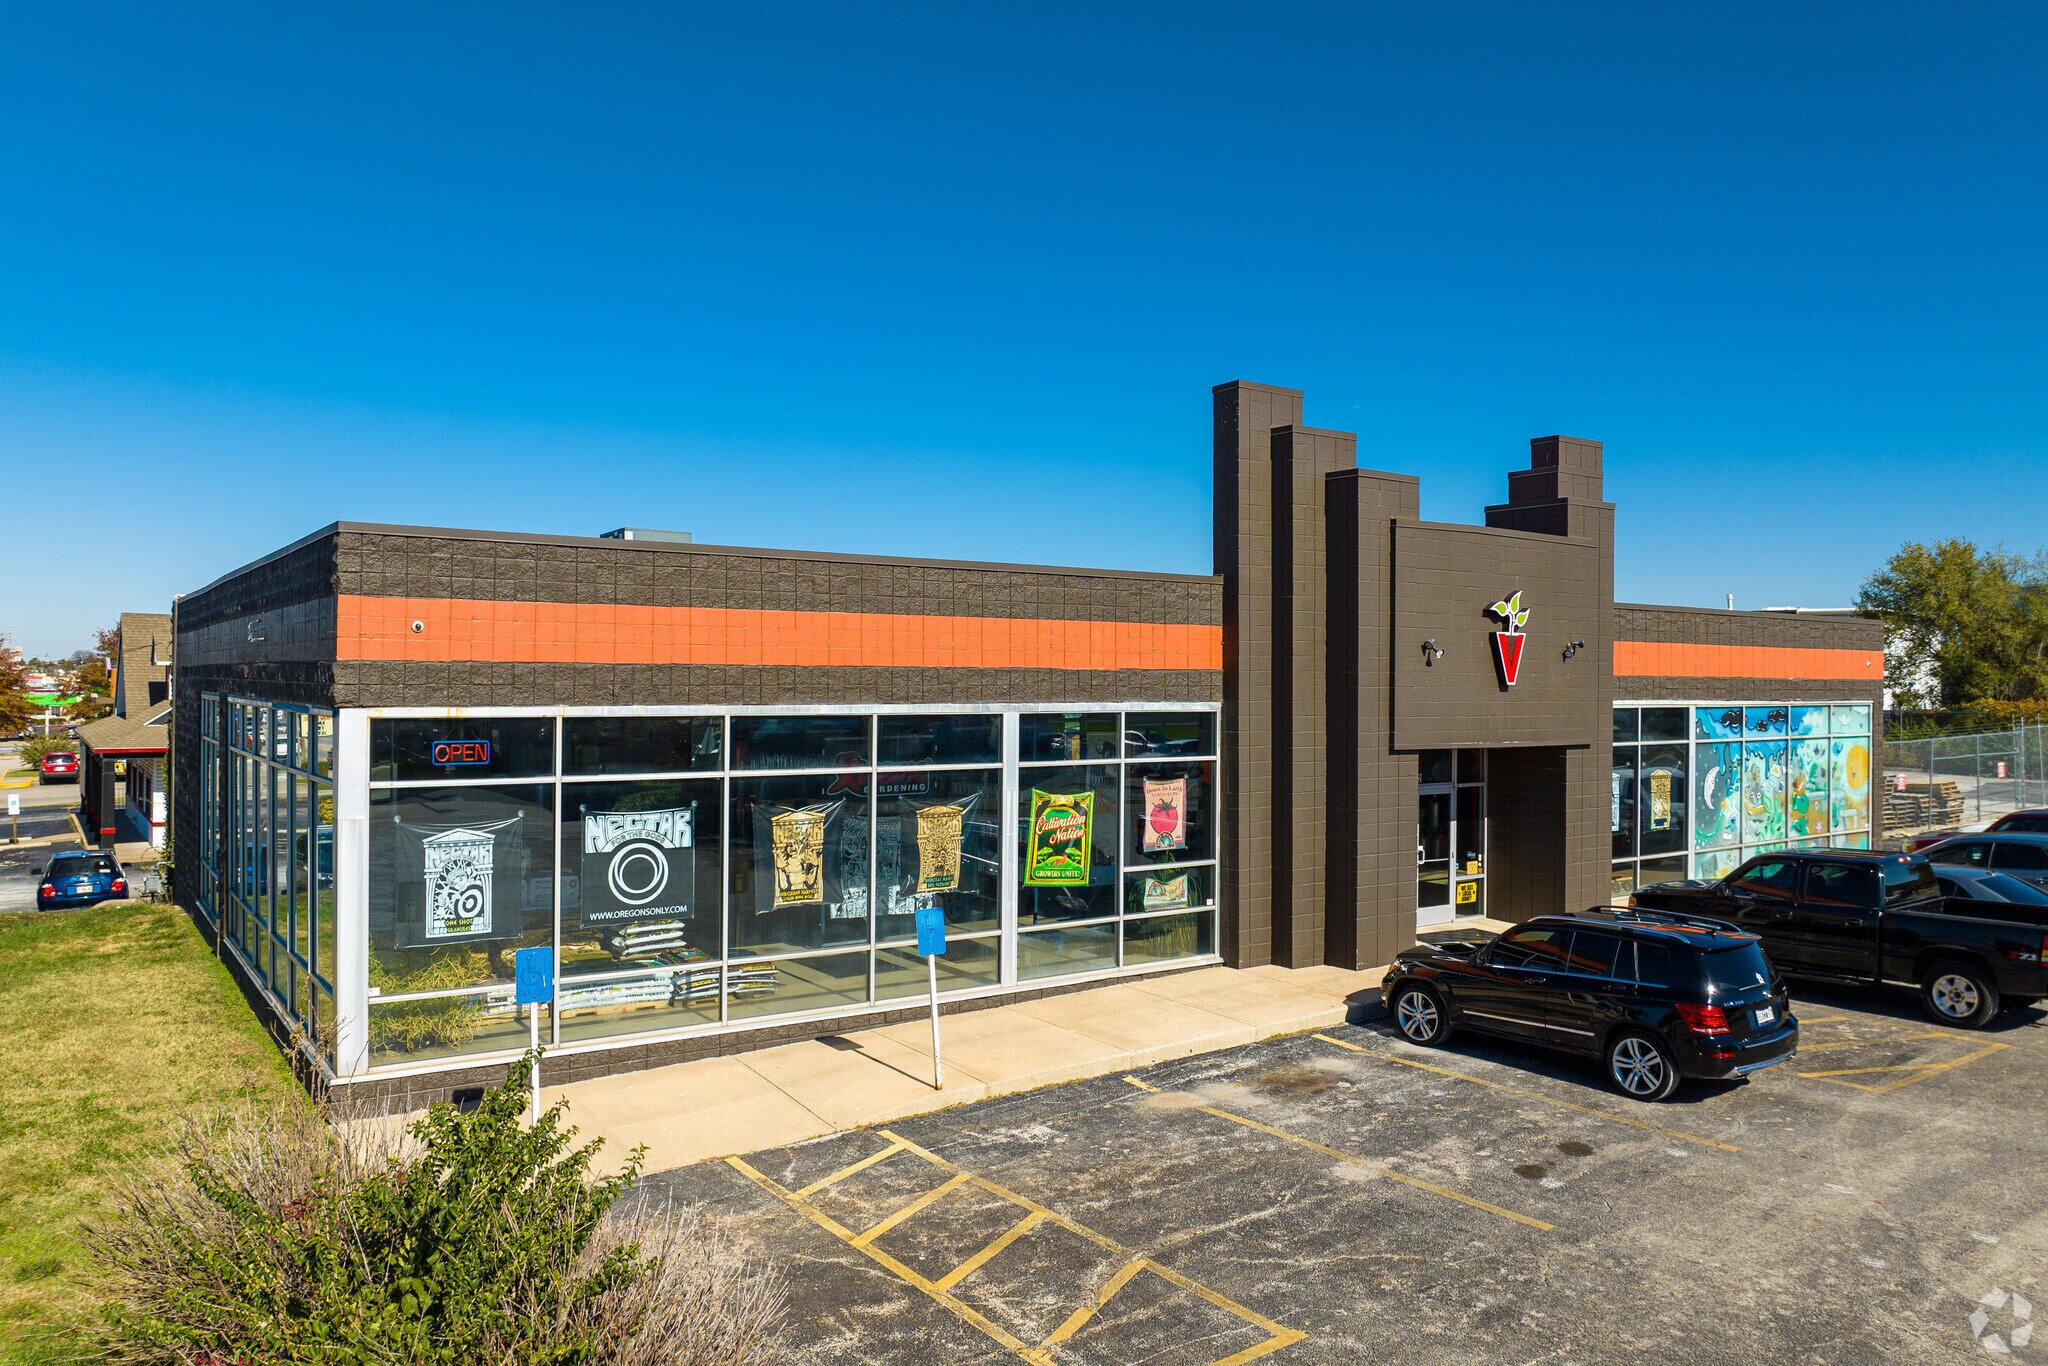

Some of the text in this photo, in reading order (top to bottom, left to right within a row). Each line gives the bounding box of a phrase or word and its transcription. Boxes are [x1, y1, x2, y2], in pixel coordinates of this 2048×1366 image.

[435, 744, 487, 762] OPEN
[863, 783, 926, 794] GRDENING
[585, 810, 692, 853] NECTAR
[1036, 814, 1086, 835] Cultivation
[611, 831, 666, 847] FOR THE GODS
[1048, 827, 1086, 845] Nation
[425, 845, 493, 870] NECTAR
[1035, 870, 1061, 878] GROWERS
[590, 904, 688, 921] WWW.OREGONSONLY.COM
